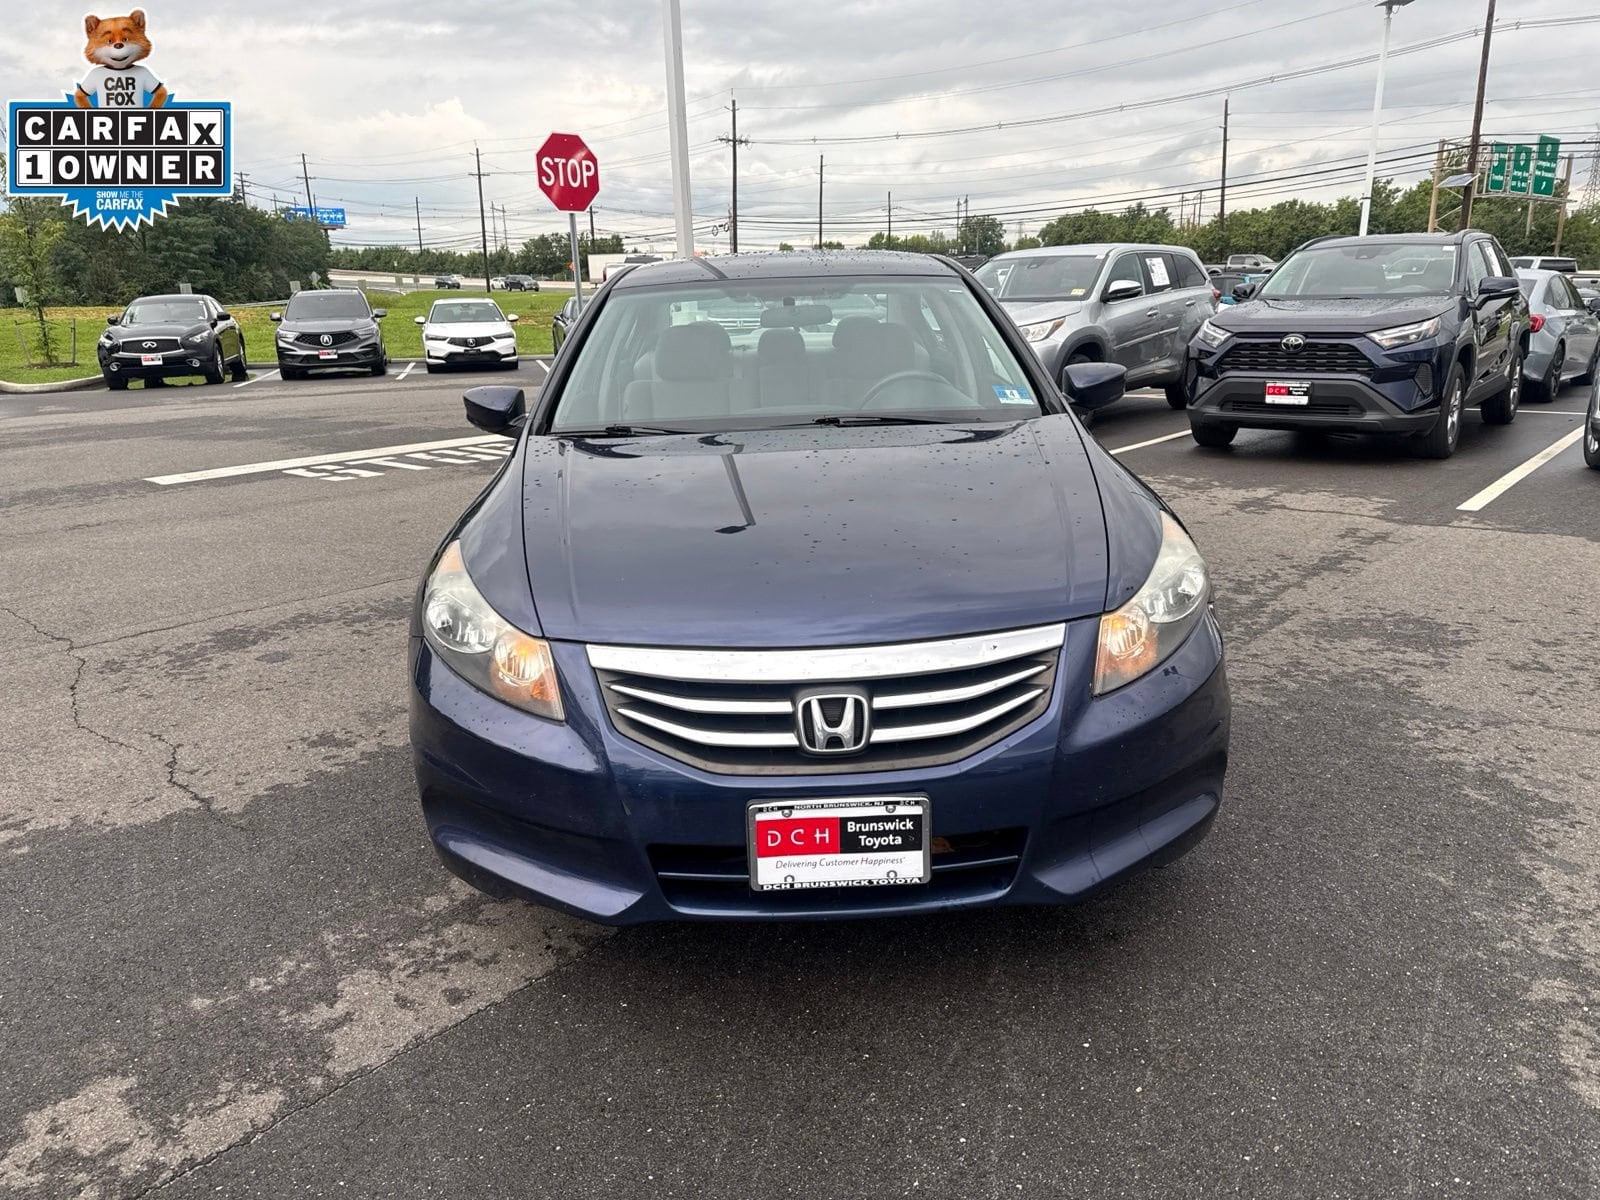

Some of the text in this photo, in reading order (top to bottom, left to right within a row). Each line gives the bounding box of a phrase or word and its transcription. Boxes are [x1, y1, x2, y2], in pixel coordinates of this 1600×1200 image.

[541, 156, 595, 188] STOP
[793, 803, 822, 811] NORTH
[847, 818, 914, 833] Brunswick
[858, 834, 902, 849] Toyota
[775, 859, 817, 869] Delivering
[819, 857, 859, 867] Customer
[763, 877, 921, 891] DCH BRUNSWICK TOYOTA
